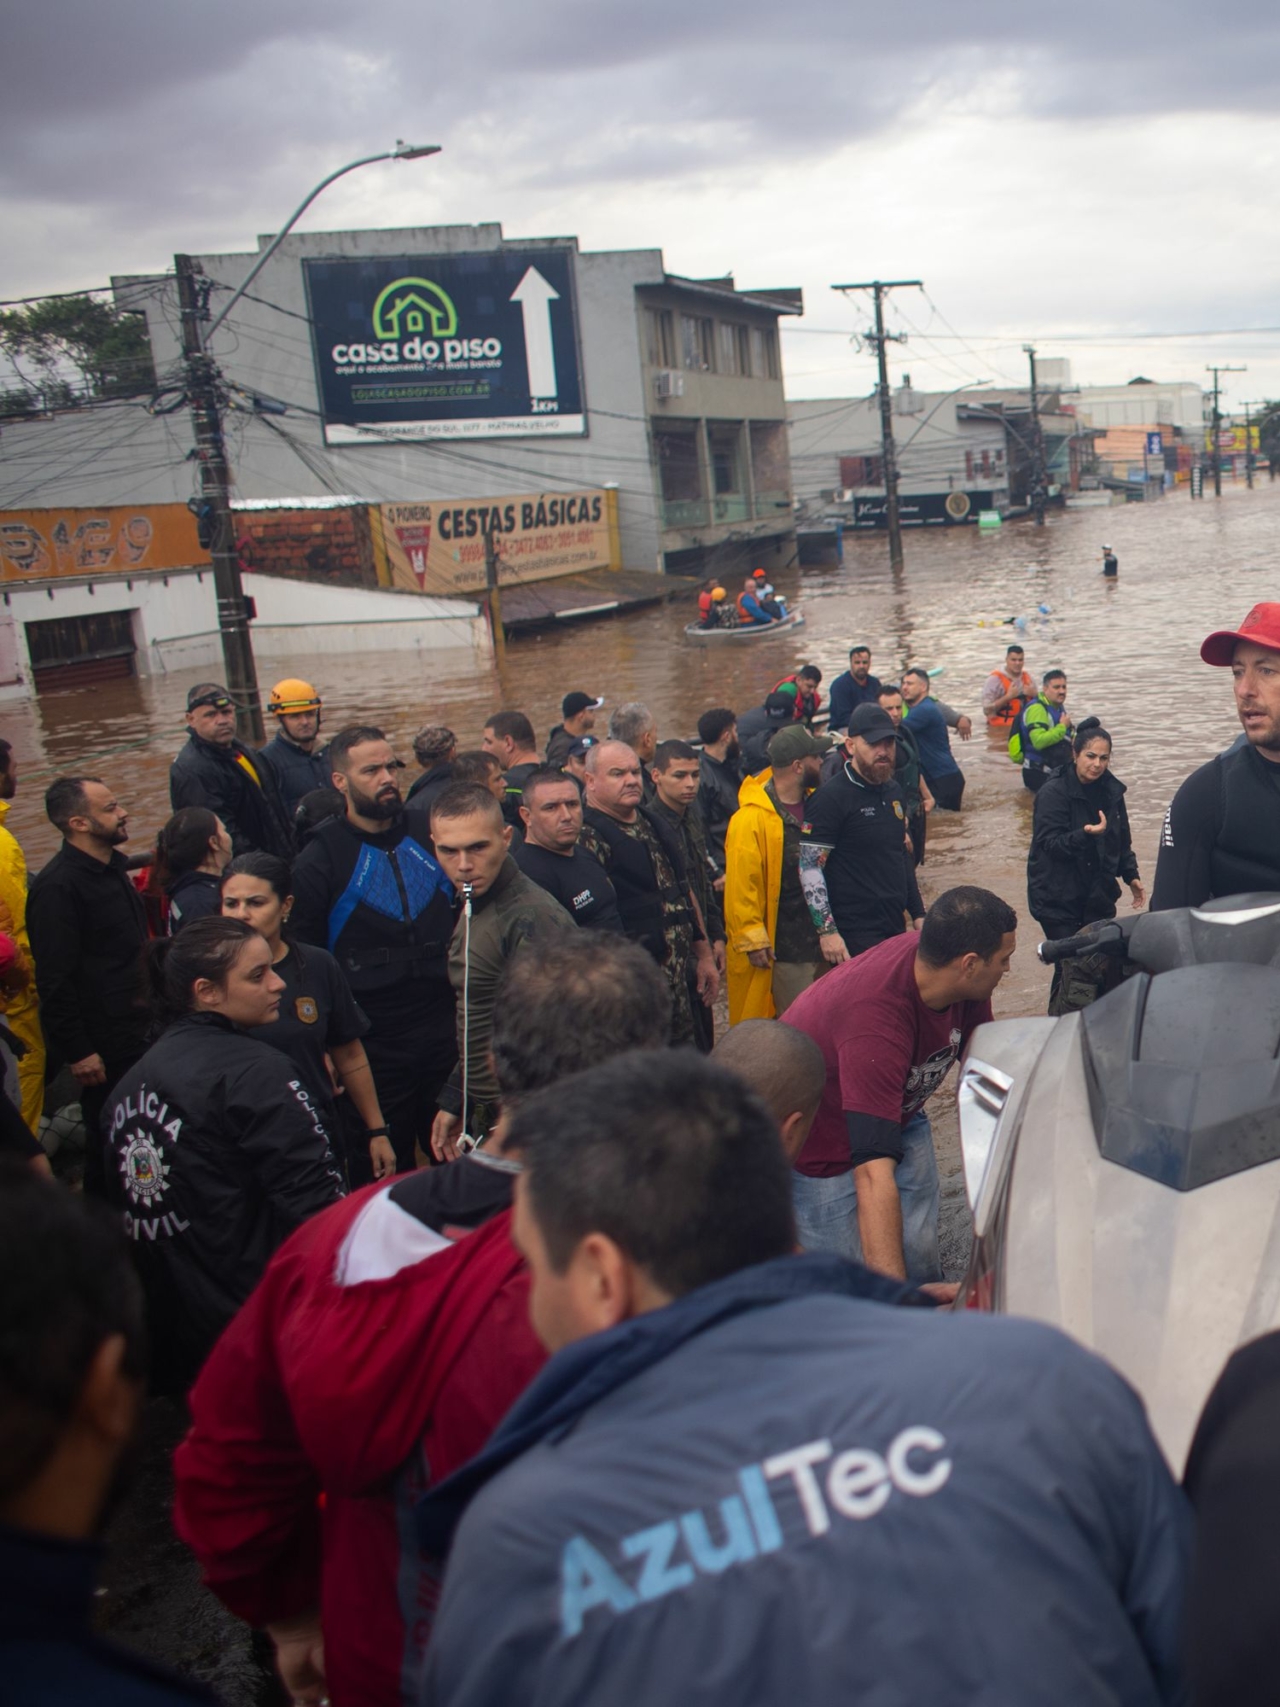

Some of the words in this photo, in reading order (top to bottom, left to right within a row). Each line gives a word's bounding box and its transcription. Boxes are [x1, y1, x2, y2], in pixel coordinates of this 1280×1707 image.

[332, 342, 399, 364] casa
[403, 337, 440, 361] do
[443, 337, 502, 363] piso
[397, 506, 432, 523] PIONEIRO
[438, 504, 516, 540] CESTAS
[522, 494, 602, 529] BÁSICAS
[109, 1083, 183, 1143] POLÍCIA
[125, 1211, 191, 1241] CIVIL
